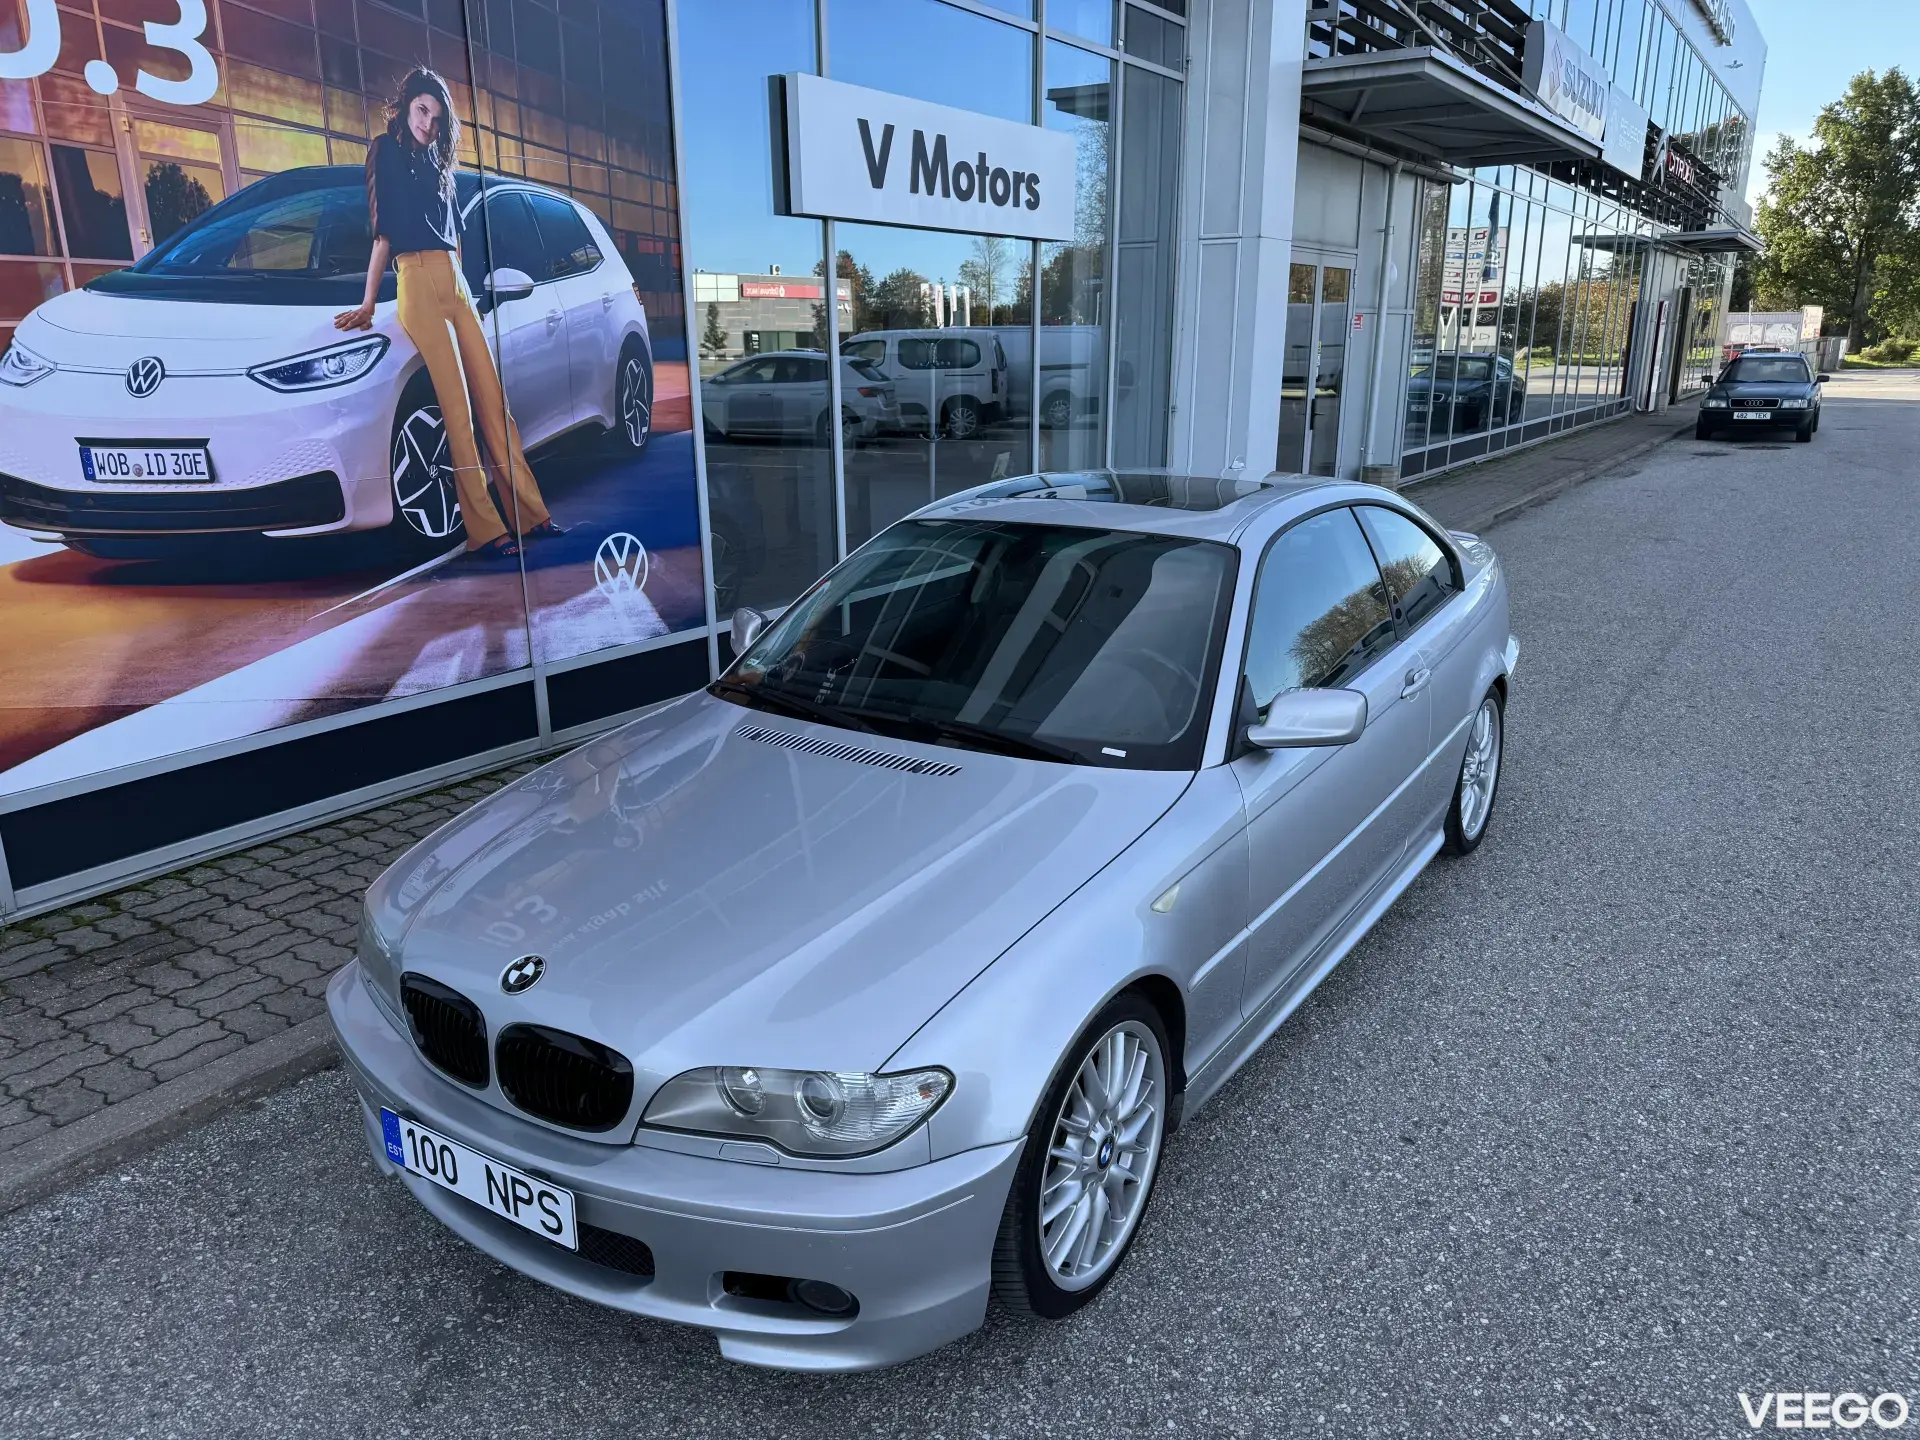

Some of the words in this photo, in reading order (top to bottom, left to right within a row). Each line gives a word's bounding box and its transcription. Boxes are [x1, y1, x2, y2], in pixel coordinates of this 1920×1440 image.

[1562, 58, 1605, 121] SUZUKI
[857, 117, 895, 189] V
[909, 129, 1041, 211] Motors
[94, 452, 130, 476] WOB
[144, 452, 167, 476] ID
[387, 1142, 404, 1159] EST
[406, 1127, 459, 1186] 100
[484, 1163, 563, 1236] NPS
